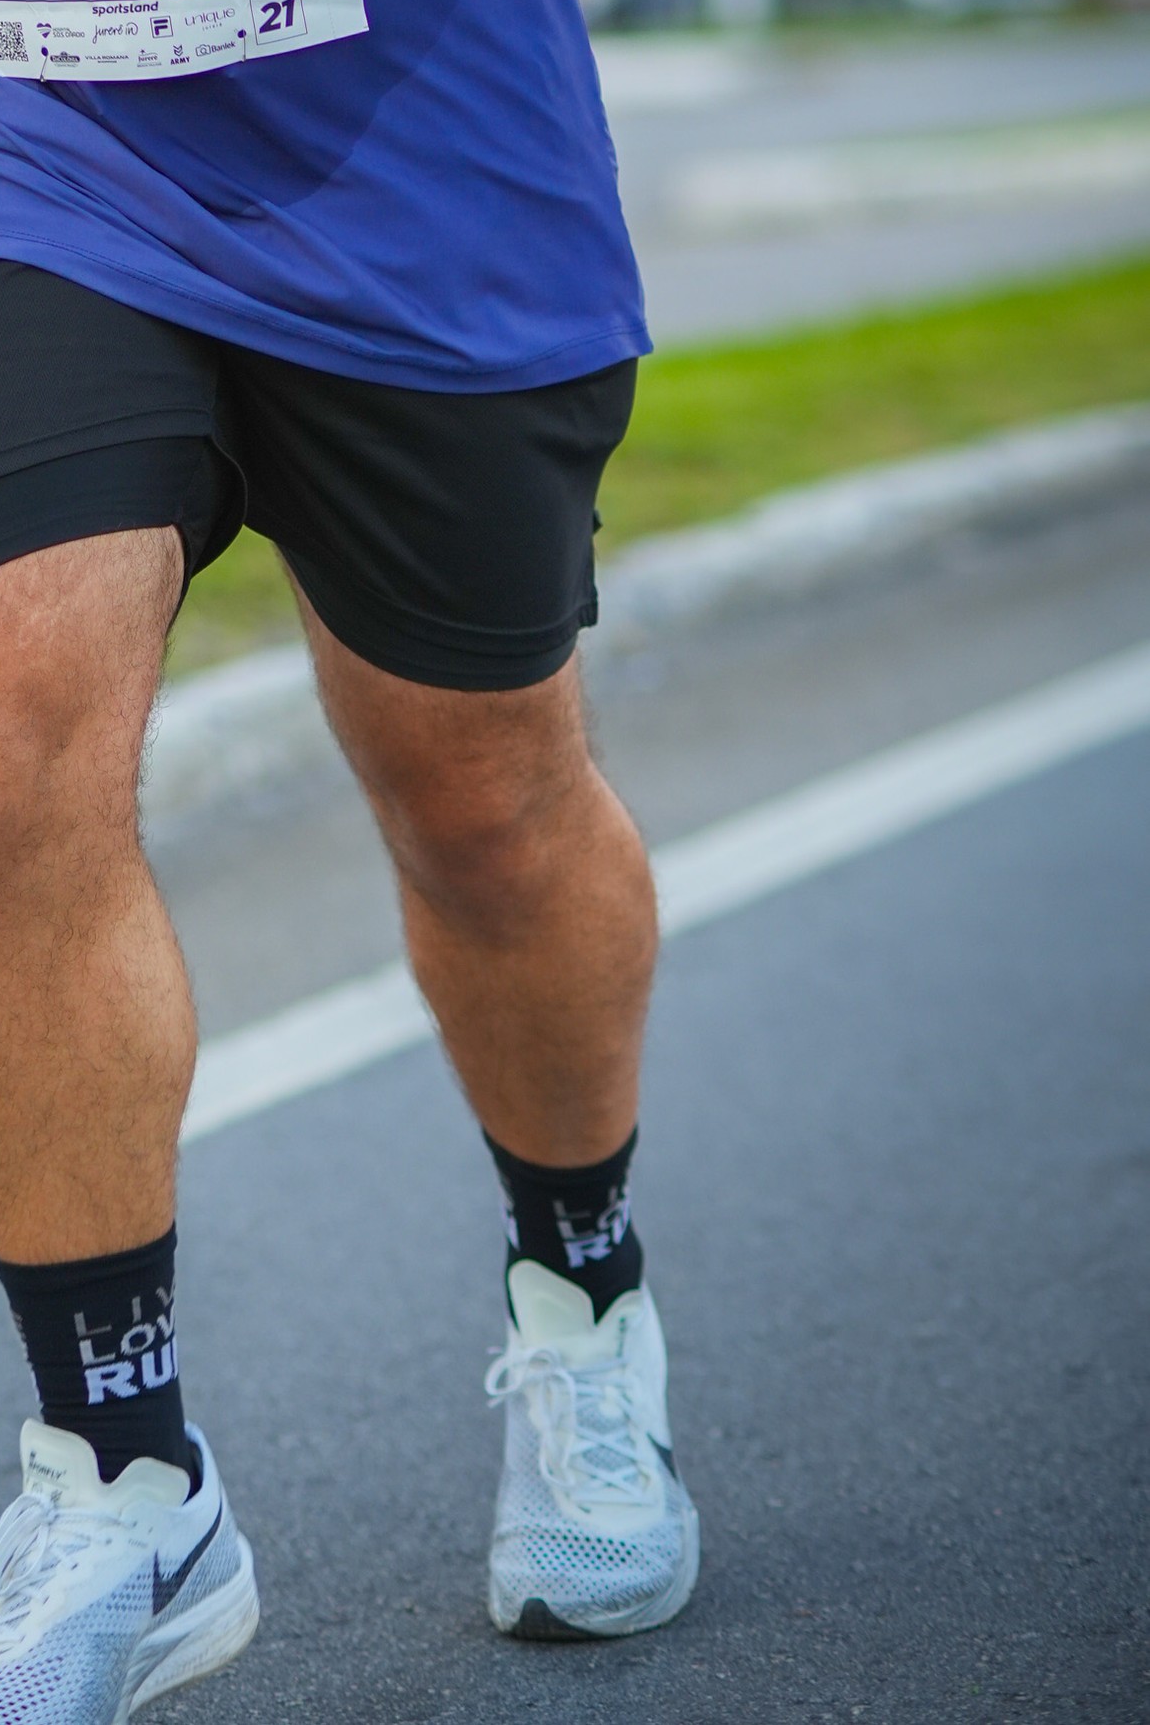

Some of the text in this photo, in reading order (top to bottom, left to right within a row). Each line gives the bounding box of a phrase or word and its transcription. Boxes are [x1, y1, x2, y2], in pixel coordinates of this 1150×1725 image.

[92, 1, 159, 17] sportsland
[170, 57, 190, 65] ARMY
[564, 1208, 629, 1268] RU
[74, 1282, 176, 1338] LIV
[79, 1313, 176, 1366] LOV
[84, 1337, 179, 1405] RU
